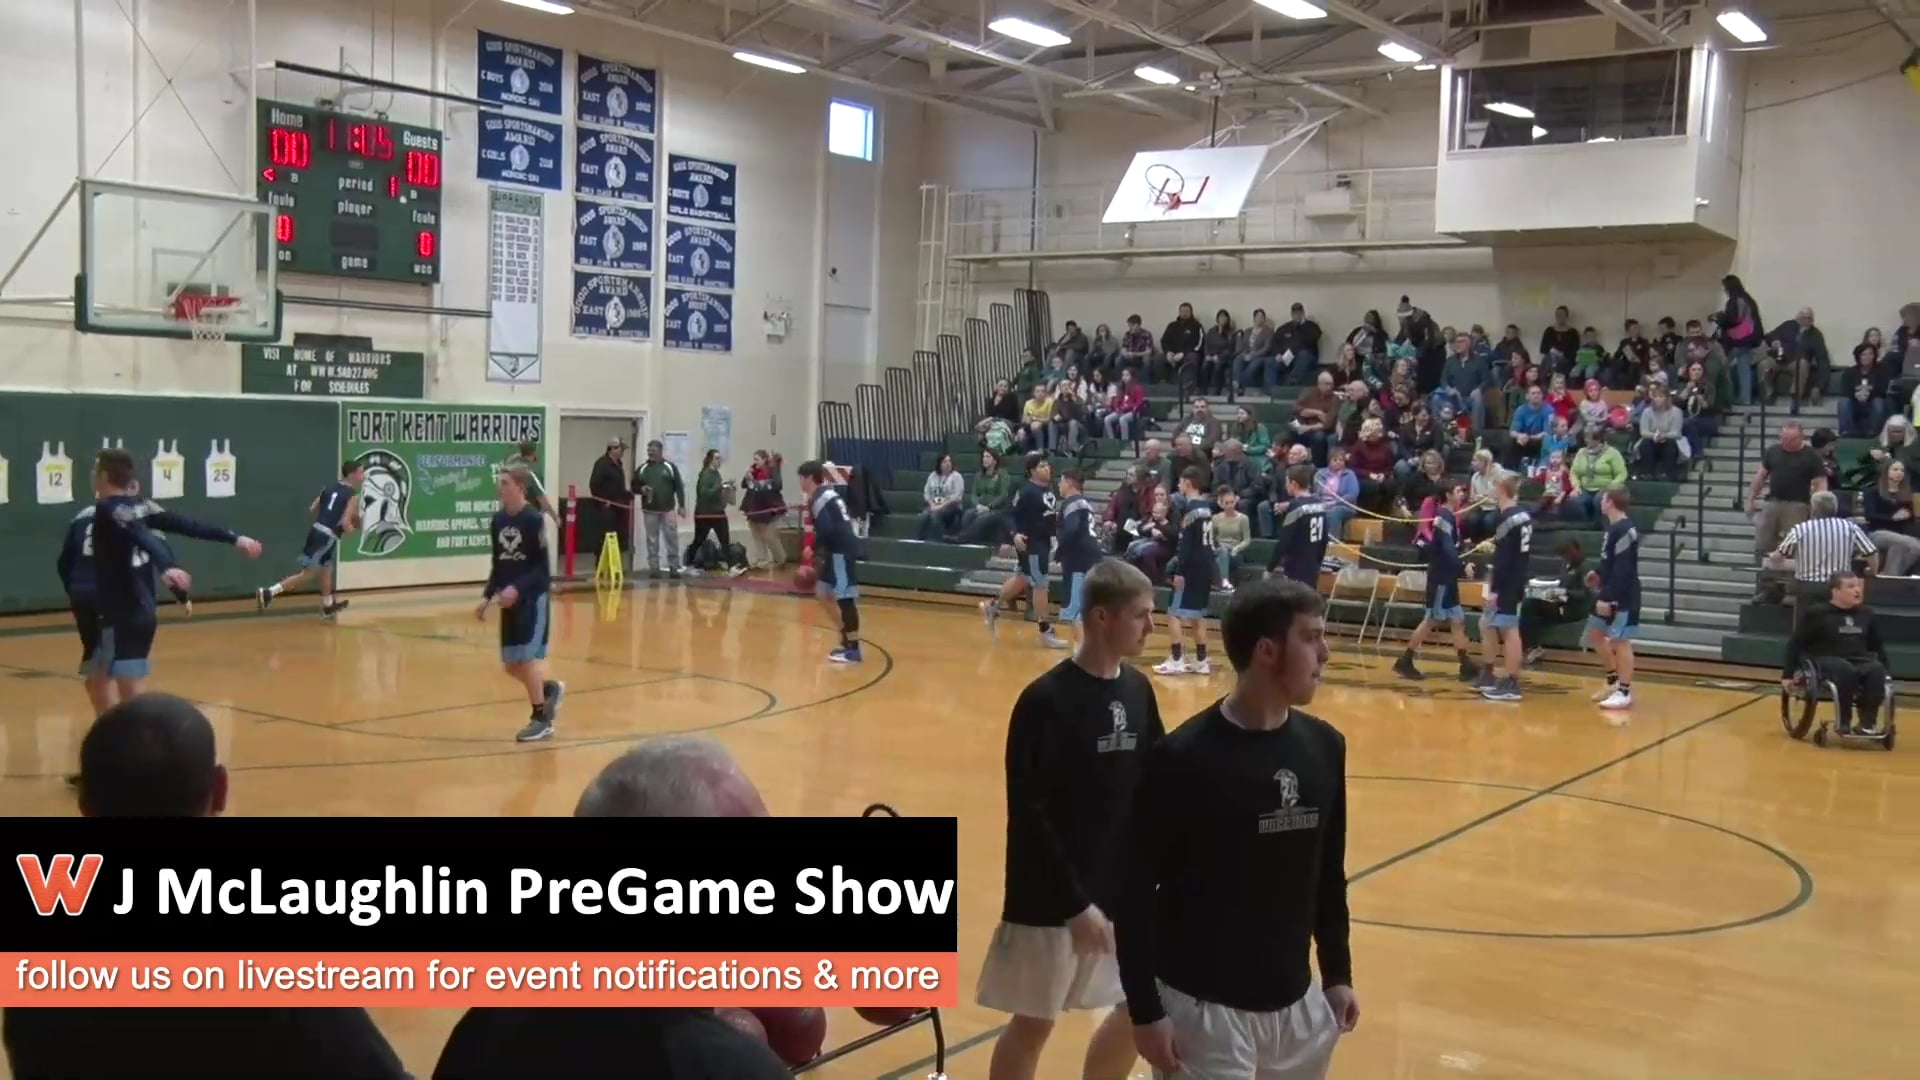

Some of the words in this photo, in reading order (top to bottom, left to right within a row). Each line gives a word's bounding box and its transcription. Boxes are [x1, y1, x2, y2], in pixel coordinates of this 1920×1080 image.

[271, 108, 304, 128] Home
[271, 128, 311, 168] 00
[403, 130, 439, 151] Guests
[406, 150, 441, 187] 00
[581, 163, 599, 176] EAST
[338, 177, 374, 192] period
[268, 191, 296, 208] fouls
[338, 200, 373, 216] player
[412, 209, 436, 225] fouls
[276, 214, 294, 243] 0
[418, 231, 436, 259] 0
[580, 235, 598, 247] EAST
[341, 255, 369, 270] game
[413, 264, 433, 275] won
[599, 285, 629, 297] AWARD
[582, 304, 605, 317] EAST
[294, 348, 317, 362] HOME
[325, 350, 336, 363] OF
[286, 363, 298, 377] AT
[294, 379, 313, 393] FOR
[329, 380, 370, 394] SCHEDULES
[348, 410, 397, 443] FORT
[400, 410, 449, 443] KENT
[452, 412, 541, 444] WARRIORS
[49, 473, 63, 487] 12
[163, 469, 172, 482] 4
[213, 469, 230, 482] 25
[1310, 516, 1324, 543] 21
